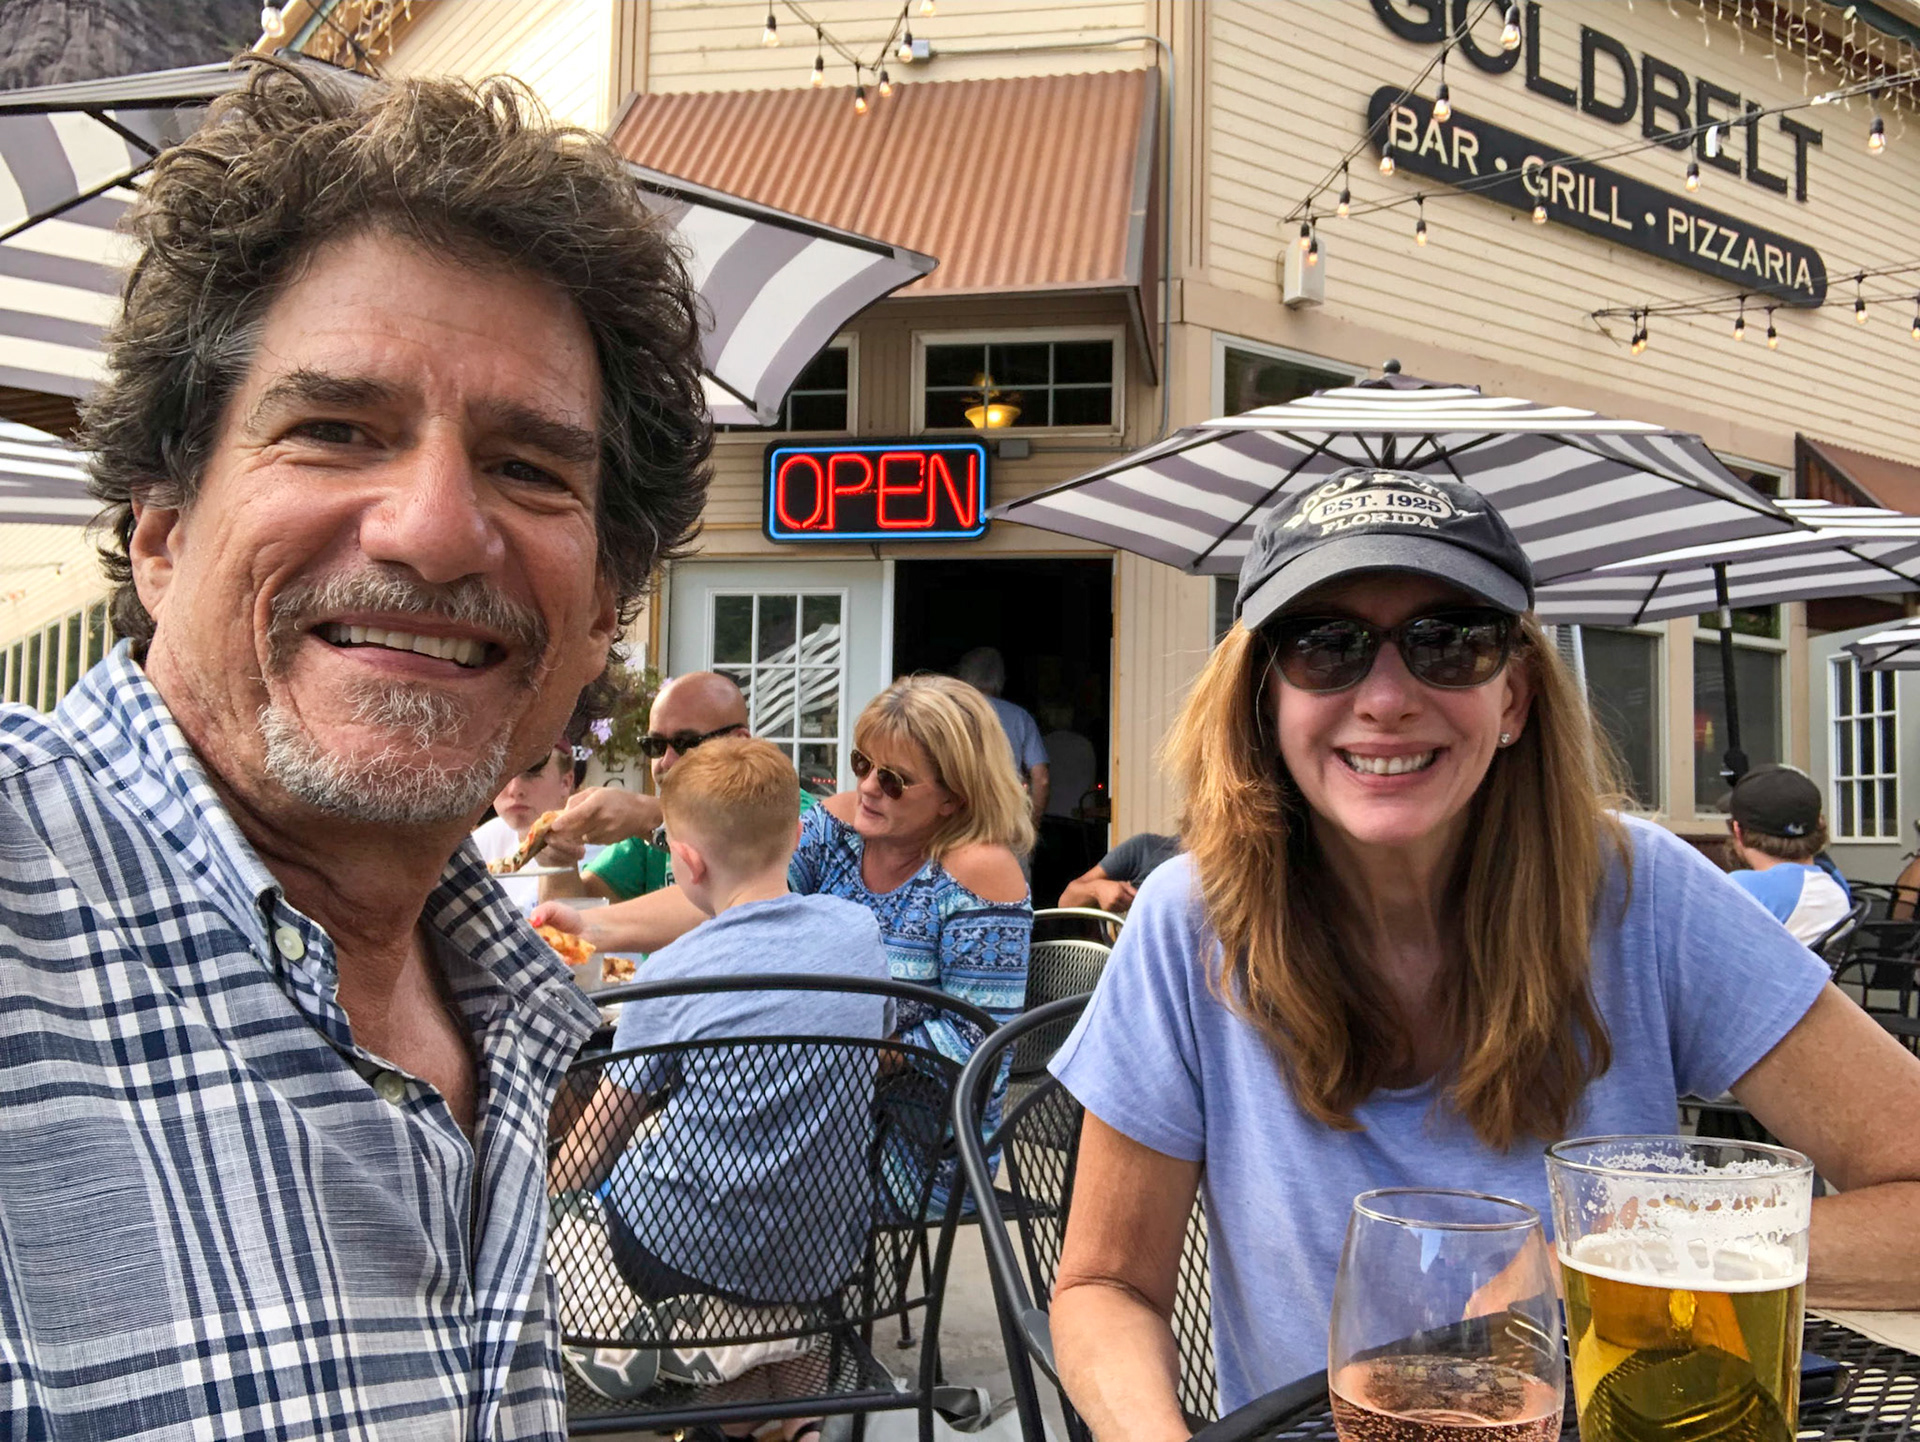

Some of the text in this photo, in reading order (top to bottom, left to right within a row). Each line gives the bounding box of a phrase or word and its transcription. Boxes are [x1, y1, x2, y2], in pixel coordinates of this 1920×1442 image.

[1389, 106, 1815, 295] BAR GRILL PIZZARIA
[777, 453, 976, 530] OPEN
[1283, 477, 1363, 530] BOCA
[1321, 493, 1442, 517] EST. 1925
[1320, 512, 1439, 537] FLORIDA
